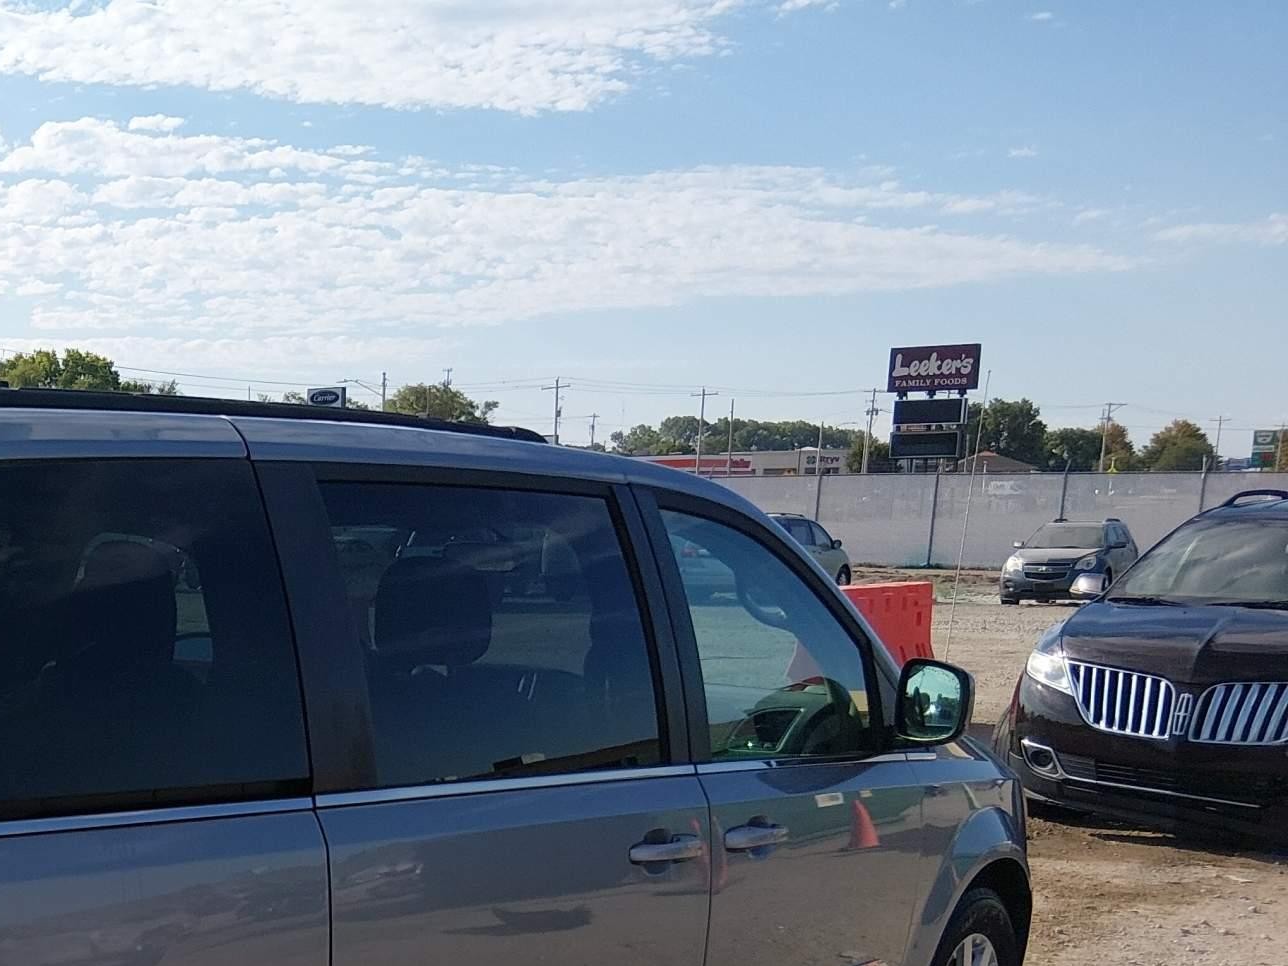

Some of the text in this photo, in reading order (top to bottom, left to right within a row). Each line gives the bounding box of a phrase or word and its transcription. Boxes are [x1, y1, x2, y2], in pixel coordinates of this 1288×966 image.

[892, 352, 973, 377] Leeker's
[895, 377, 967, 387] FAMILY FOODS
[314, 393, 337, 402] Carrier
